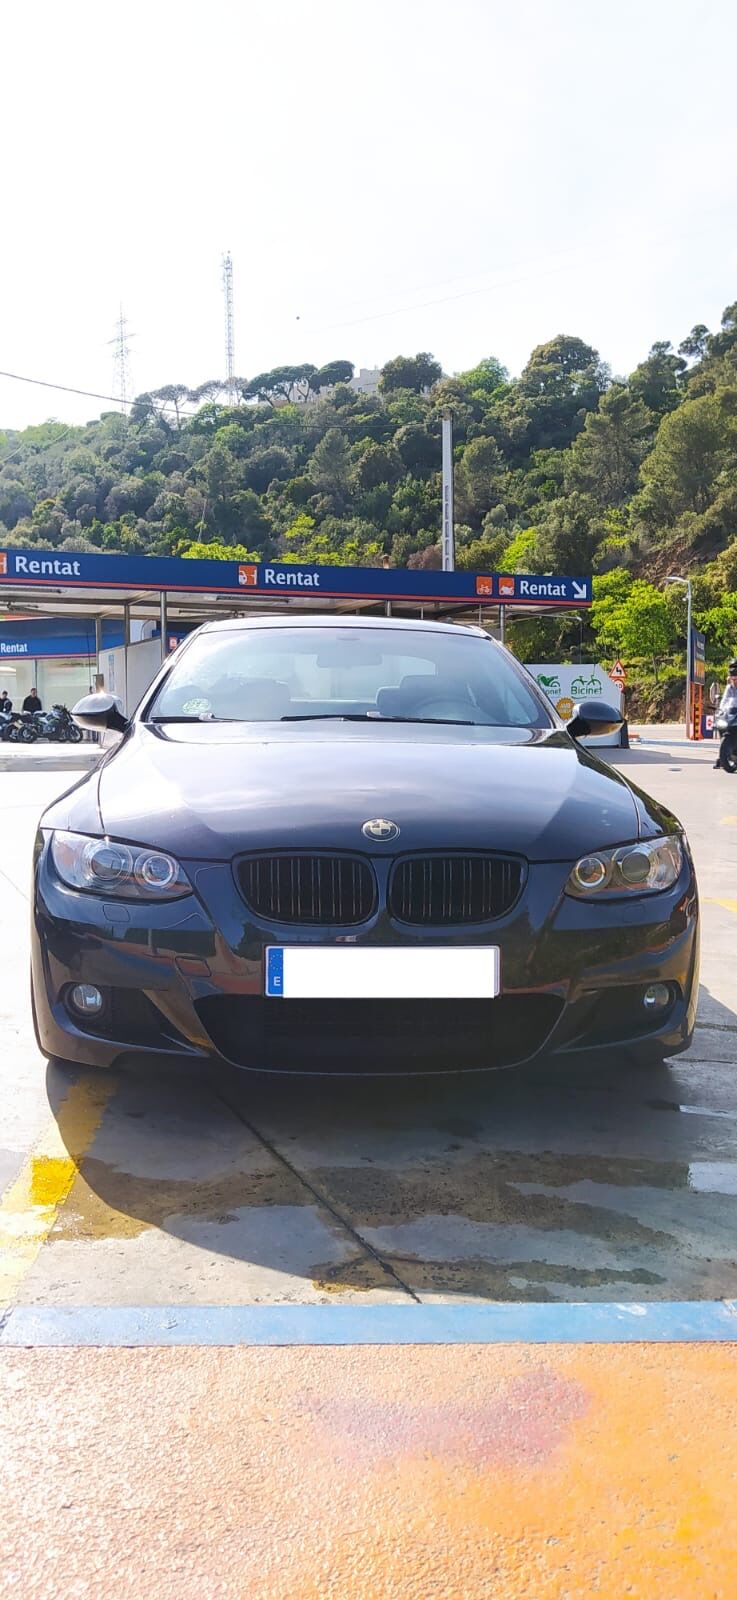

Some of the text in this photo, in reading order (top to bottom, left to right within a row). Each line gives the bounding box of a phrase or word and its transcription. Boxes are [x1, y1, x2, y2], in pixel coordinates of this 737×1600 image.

[15, 556, 80, 575] Rentat
[264, 568, 320, 586] Rentat
[520, 580, 566, 596] Rentat
[0, 642, 28, 653] Rentat
[273, 976, 281, 986] E
